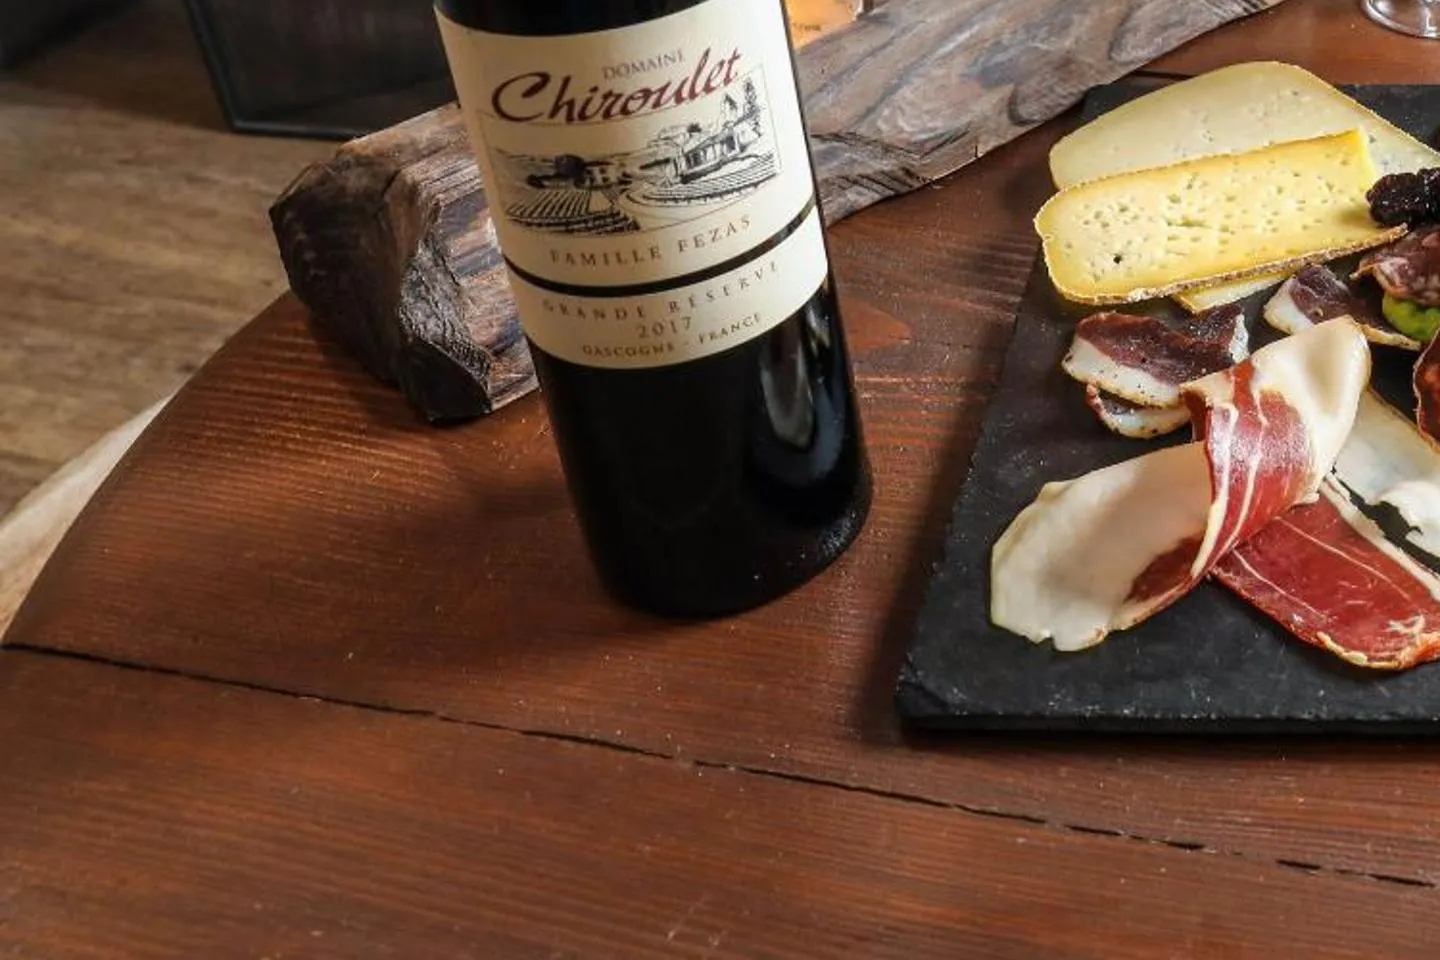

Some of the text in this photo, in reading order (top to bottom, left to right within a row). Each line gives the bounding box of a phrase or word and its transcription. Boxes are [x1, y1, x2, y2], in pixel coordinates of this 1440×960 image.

[602, 49, 684, 81] DOMAINE
[491, 46, 741, 124] Chiroulet
[550, 215, 751, 267] FAMILLE FEZAS
[543, 299, 647, 320] GRANDE
[638, 315, 692, 339] 2017
[582, 313, 762, 357] GASCOGNE FRANCE
